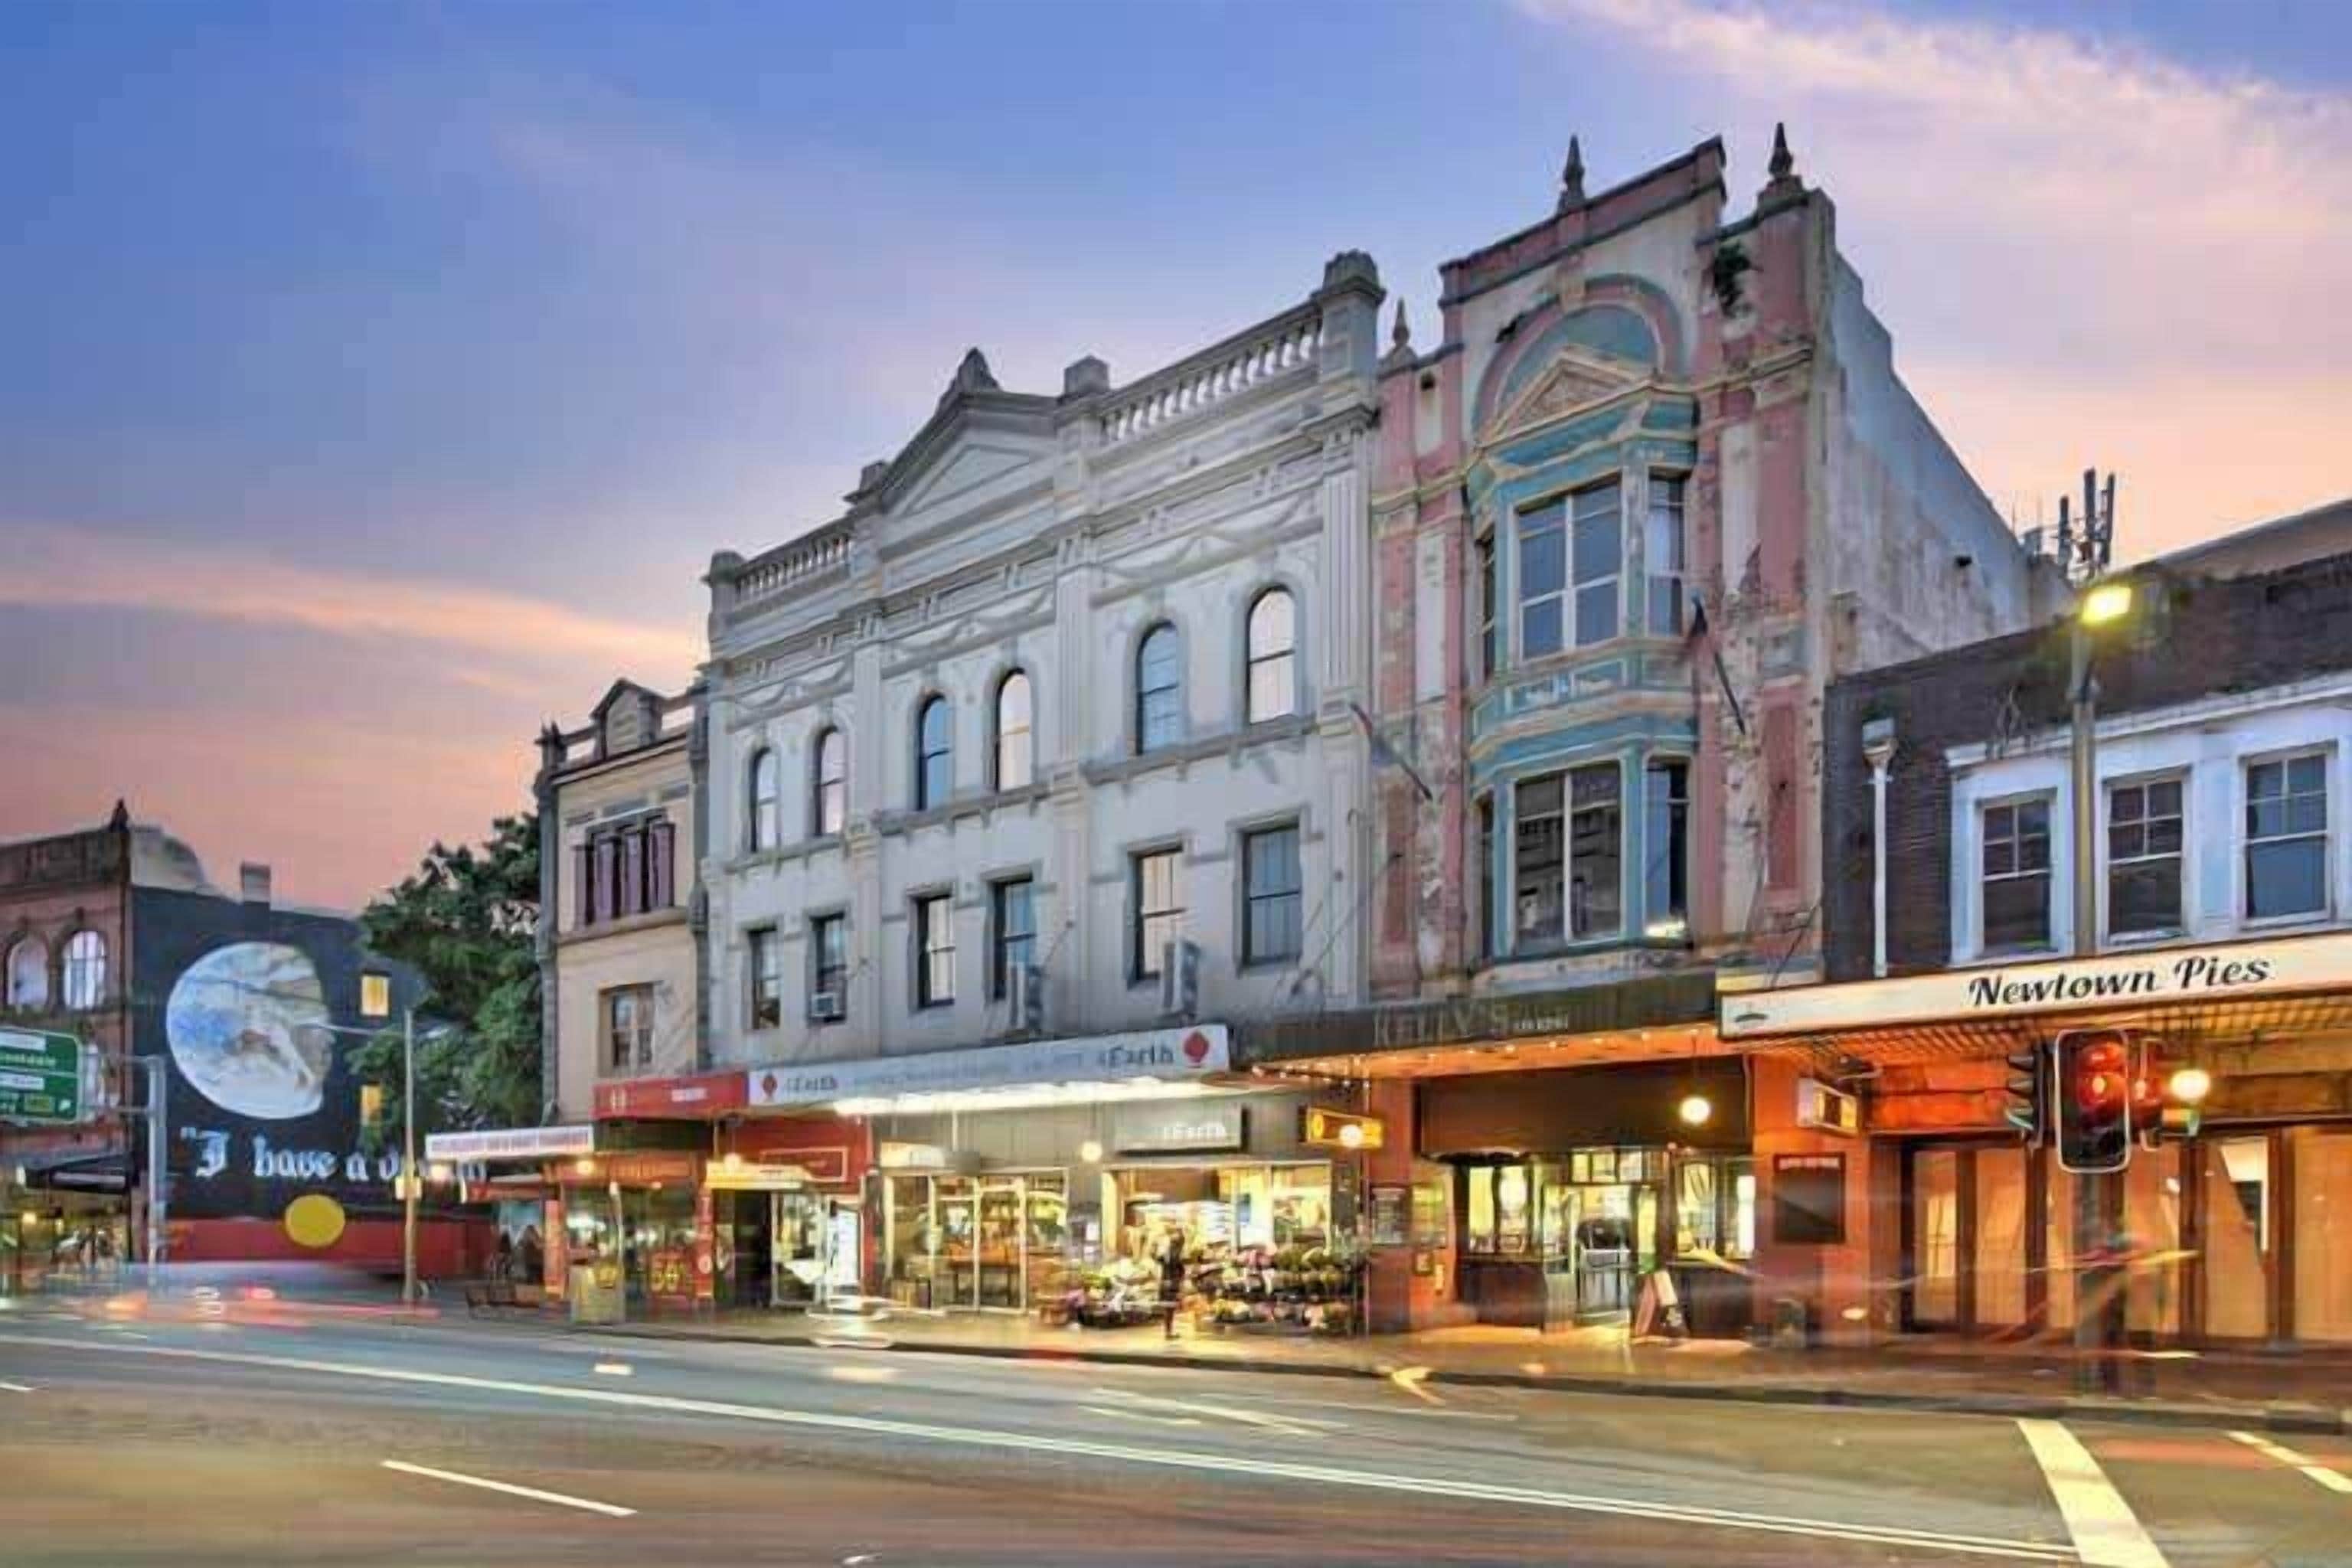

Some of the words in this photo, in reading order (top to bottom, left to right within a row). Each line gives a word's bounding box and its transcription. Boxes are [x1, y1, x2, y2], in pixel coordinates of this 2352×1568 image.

[1968, 968, 2159, 1007] Newtown
[2174, 954, 2272, 990] Pies
[253, 1135, 337, 1181] have
[345, 1151, 370, 1182] a
